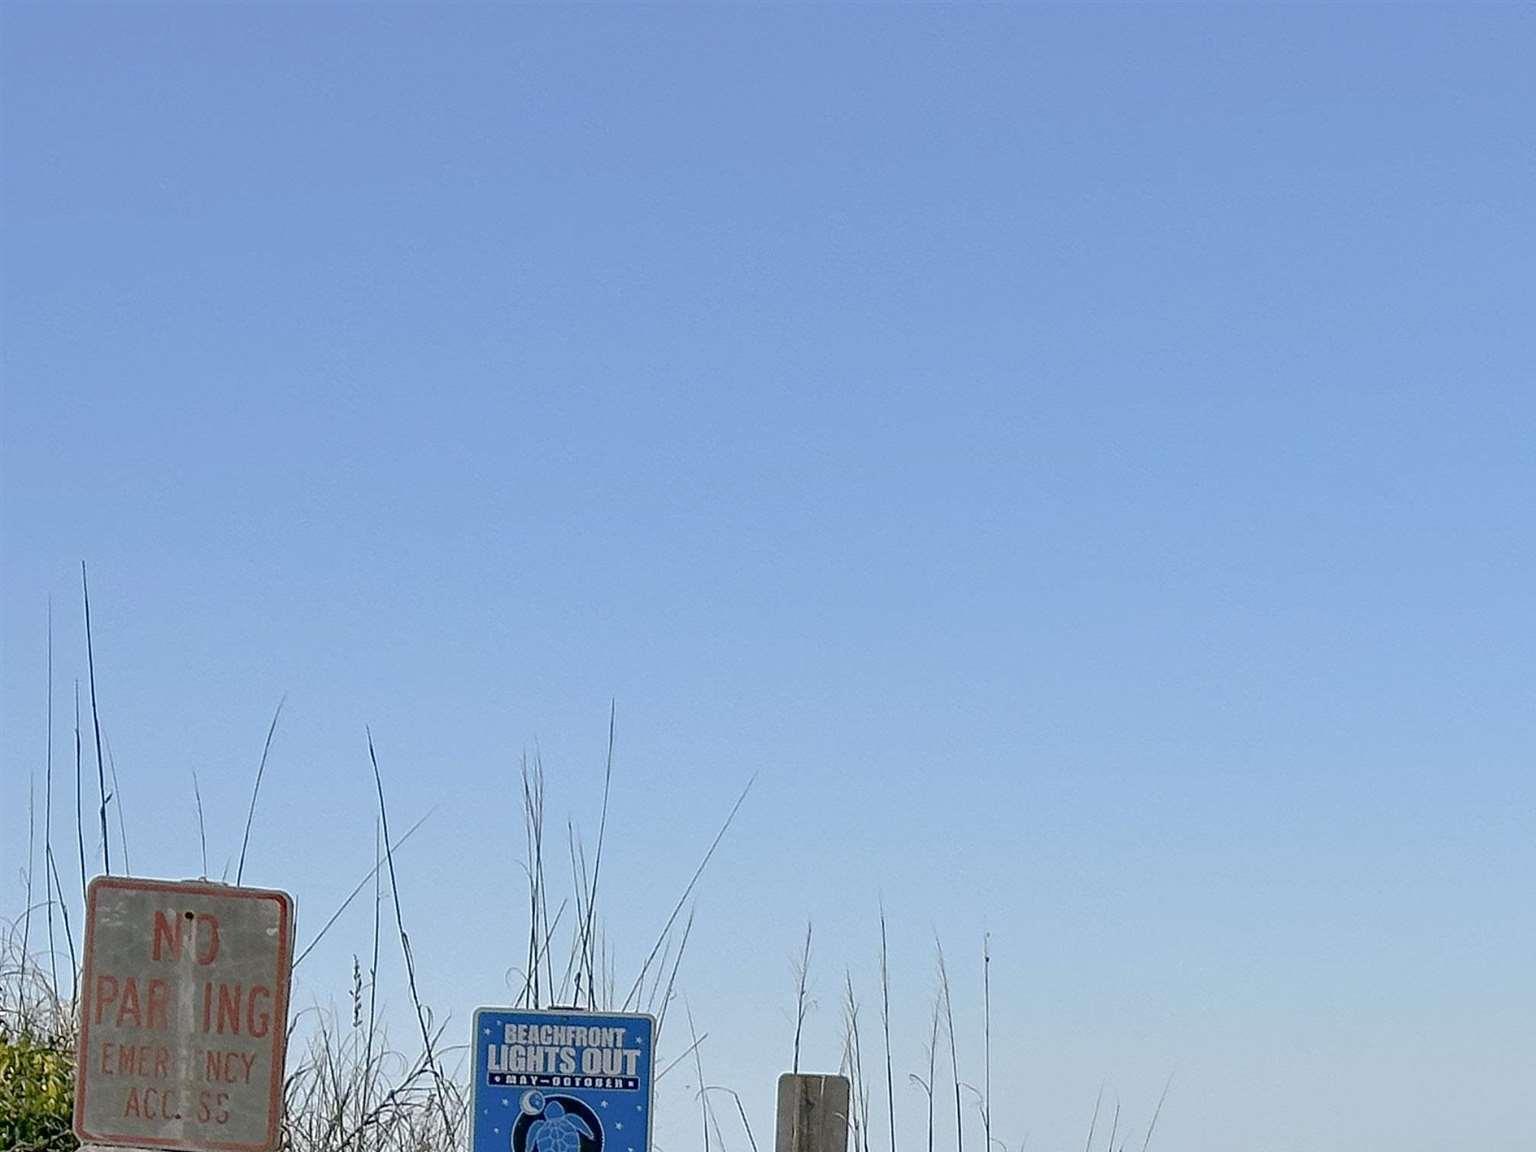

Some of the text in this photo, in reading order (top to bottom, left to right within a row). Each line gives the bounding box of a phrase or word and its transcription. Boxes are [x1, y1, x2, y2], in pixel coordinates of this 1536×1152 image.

[152, 911, 220, 965] NO
[95, 975, 270, 1038] PARING
[504, 1023, 626, 1047] BEACHFRONT
[487, 1044, 641, 1076] LIGHTS OUT
[124, 1087, 229, 1124] ACCSS
